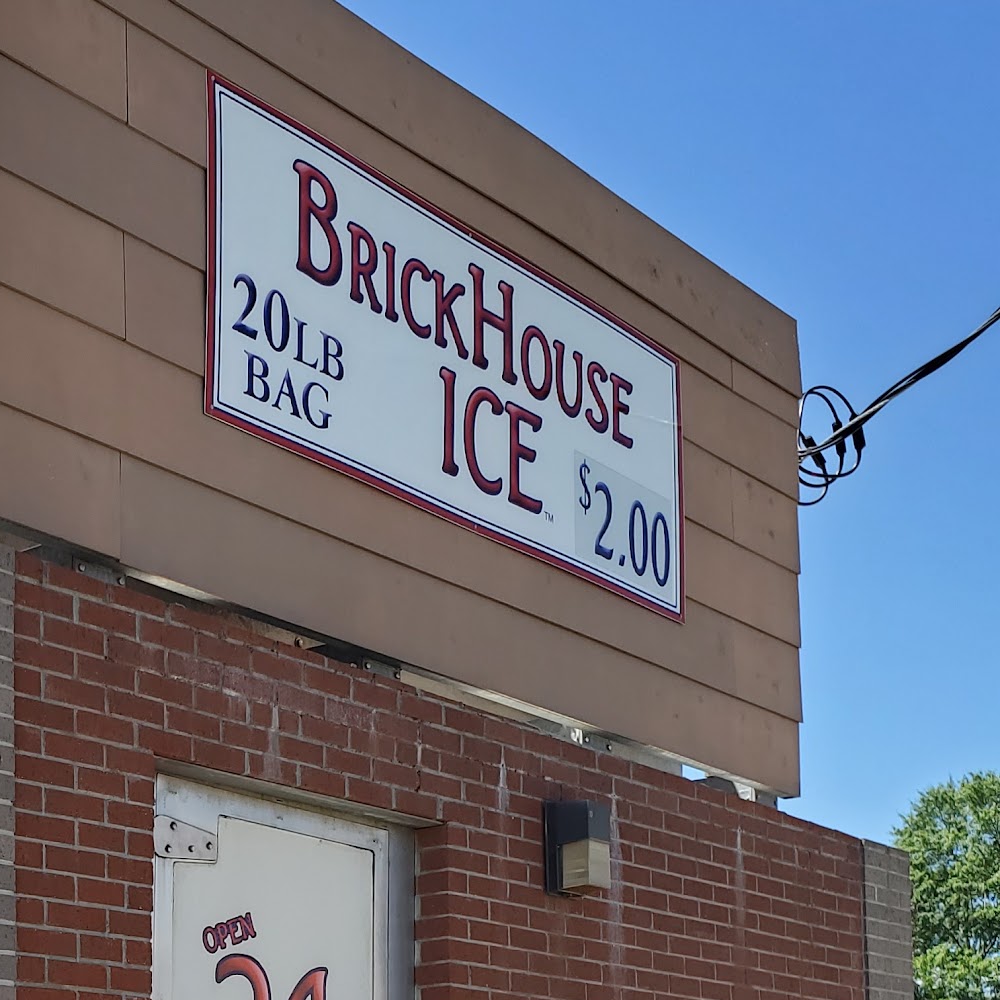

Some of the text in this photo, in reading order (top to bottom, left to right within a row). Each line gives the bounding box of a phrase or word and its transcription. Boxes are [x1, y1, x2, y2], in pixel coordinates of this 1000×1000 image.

[231, 273, 344, 381] 20LB
[292, 159, 634, 449] BRICKHOUSE
[243, 350, 332, 429] BAG
[439, 366, 543, 514] ICE
[579, 458, 670, 587] $2.00
[202, 912, 257, 953] OPEN
